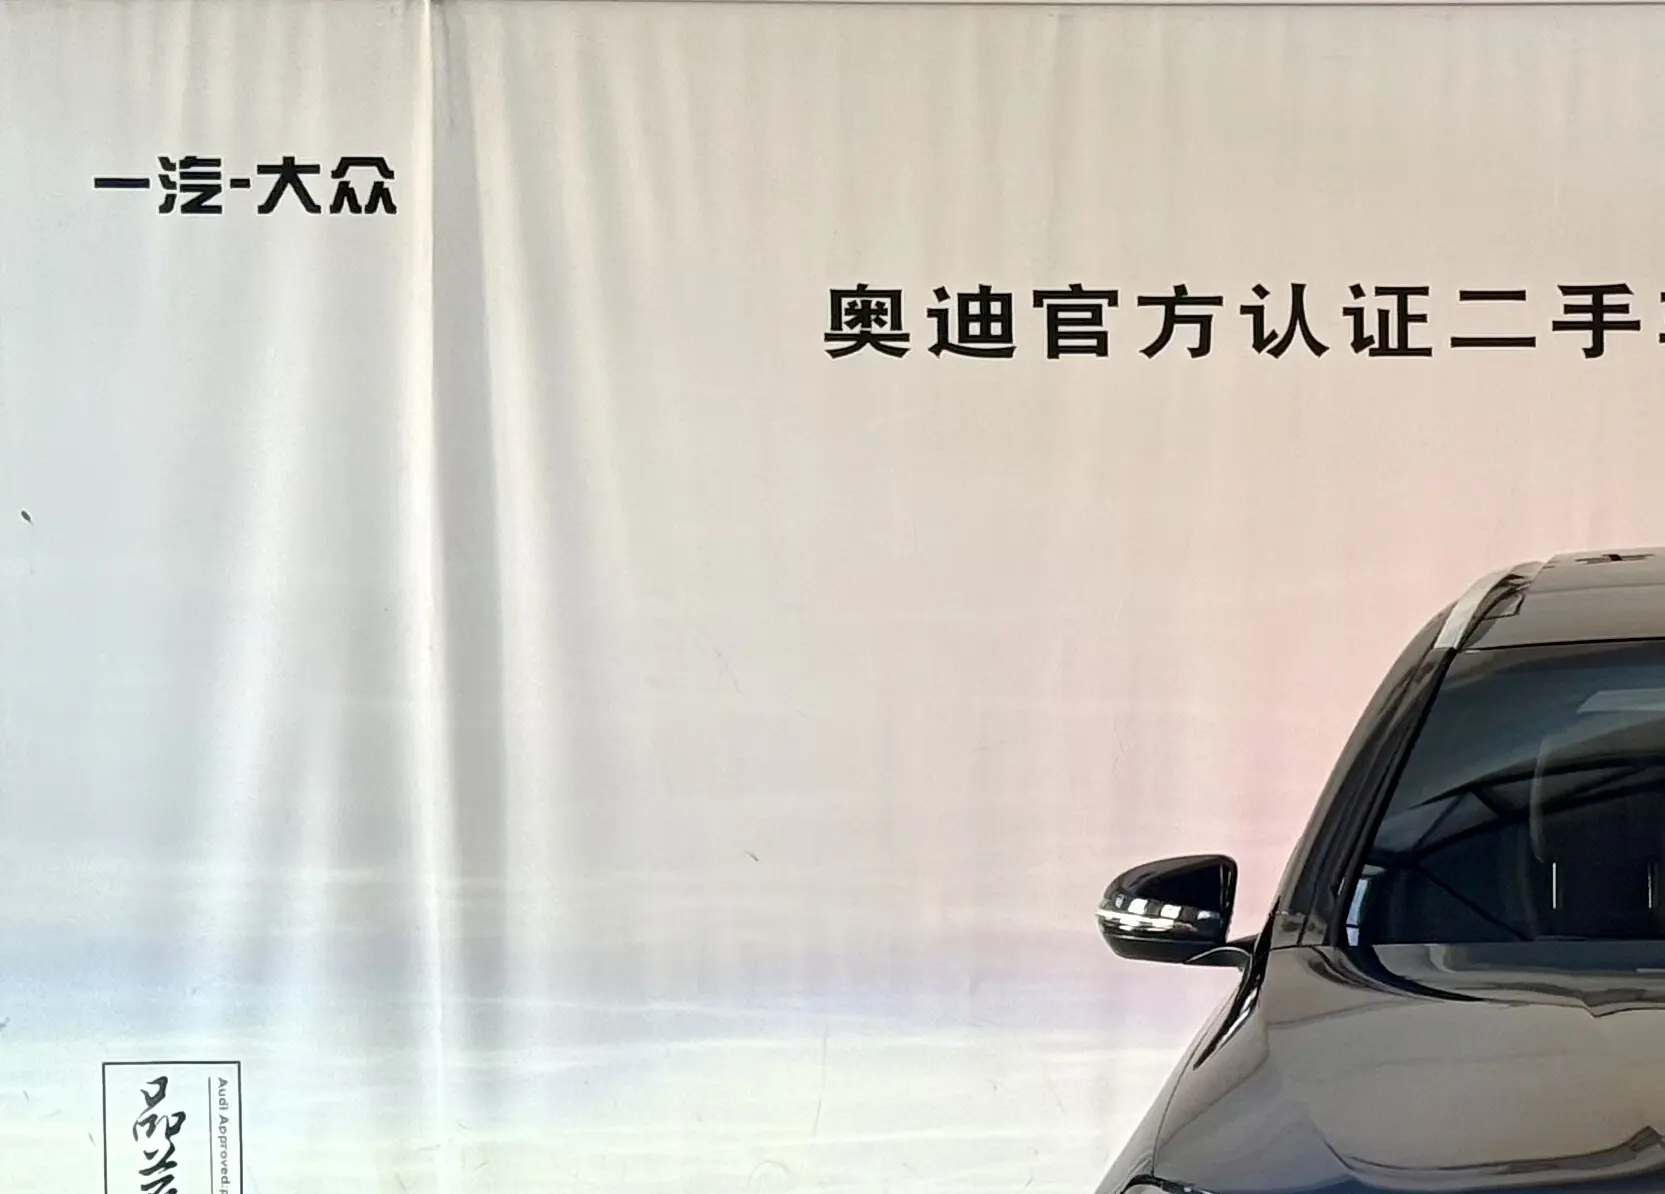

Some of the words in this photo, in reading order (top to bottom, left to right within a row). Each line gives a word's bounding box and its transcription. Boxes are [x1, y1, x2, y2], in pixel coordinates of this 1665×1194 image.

[93, 155, 398, 215] 一汽-大众
[217, 1076, 230, 1111] Audi
